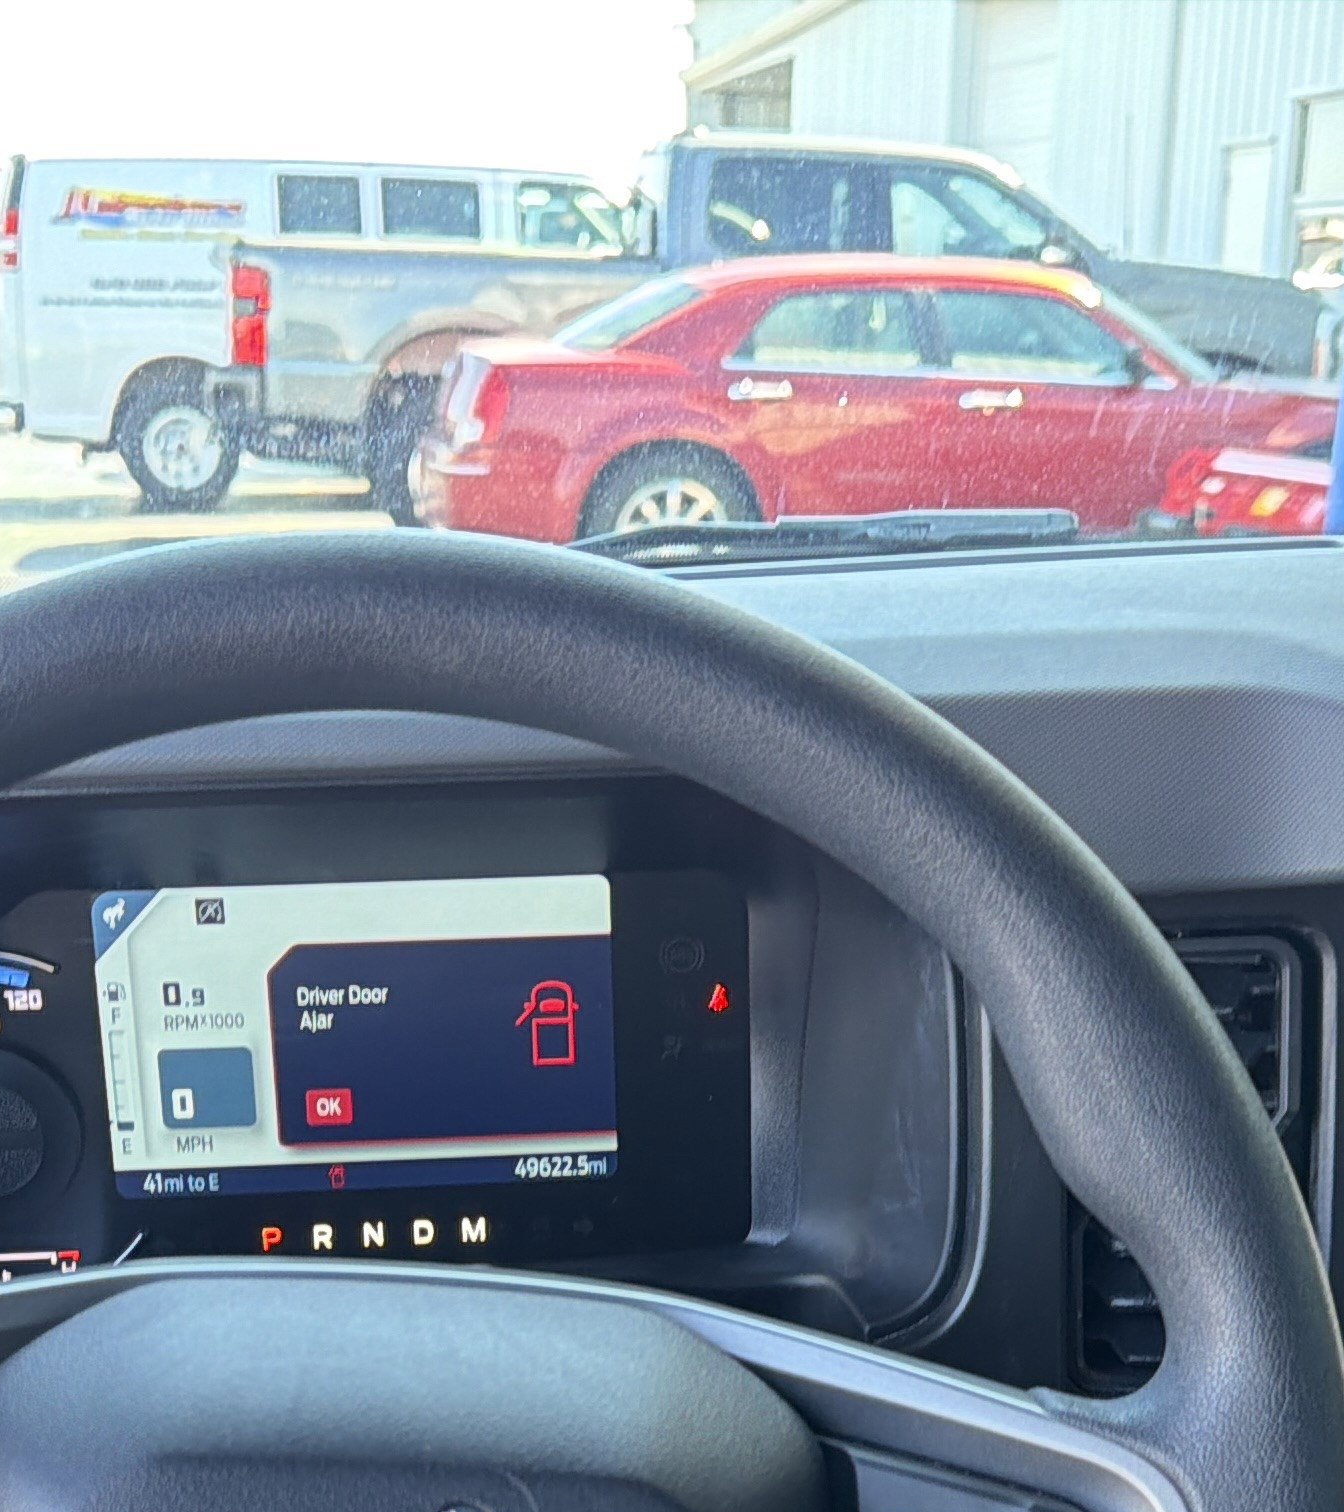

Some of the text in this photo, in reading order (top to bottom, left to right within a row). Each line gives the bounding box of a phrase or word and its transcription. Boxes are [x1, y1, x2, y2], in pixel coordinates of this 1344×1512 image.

[4, 990, 43, 1011] 120
[296, 985, 389, 1006] Driver Door
[111, 1007, 121, 1025] F
[299, 1011, 334, 1033] Ajar
[171, 1088, 194, 1120] 0
[316, 1098, 342, 1116] OK
[122, 1138, 133, 1155] E
[176, 1135, 213, 1153] MPH
[514, 1155, 607, 1179] 49622.5mi
[188, 1174, 203, 1191] to
[209, 1173, 219, 1191] E
[261, 1216, 486, 1253] P R N D M
